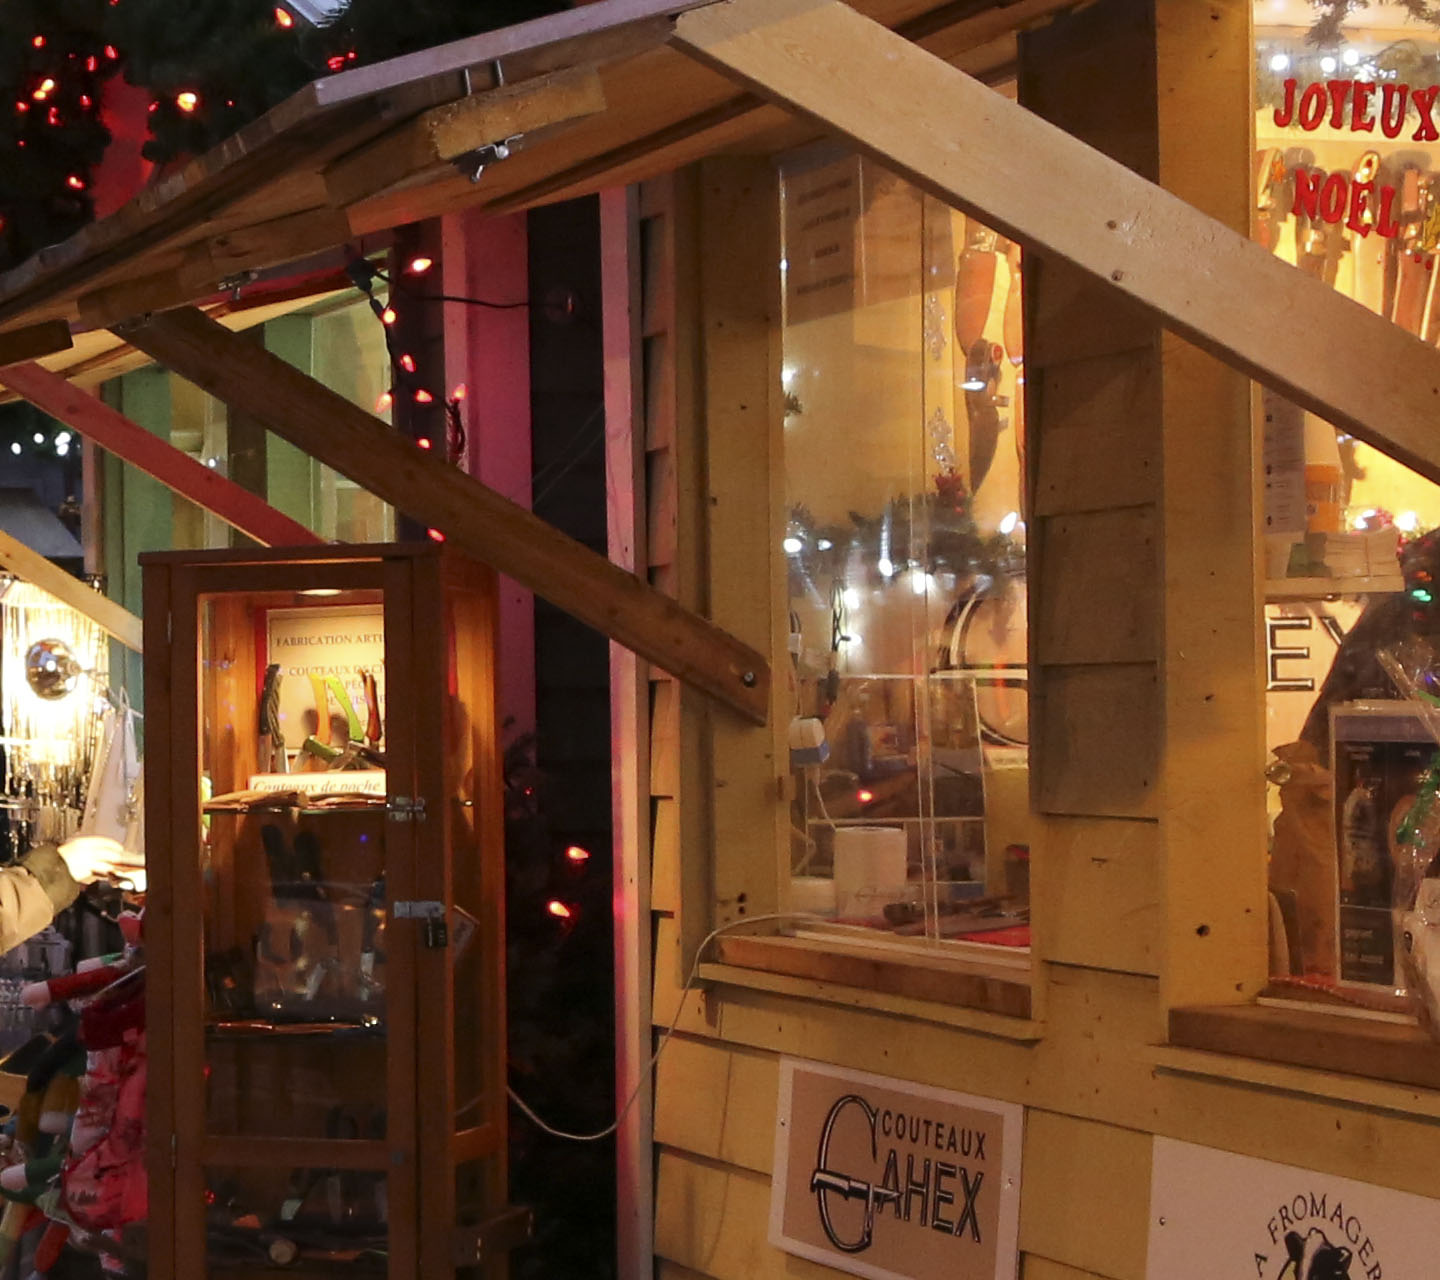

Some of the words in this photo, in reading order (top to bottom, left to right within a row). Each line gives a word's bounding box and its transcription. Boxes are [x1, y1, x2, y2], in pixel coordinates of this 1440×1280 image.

[1273, 78, 1440, 142] JOYEUX
[275, 634, 353, 647] FABRICATION
[880, 1109, 988, 1162] COUTEAUX
